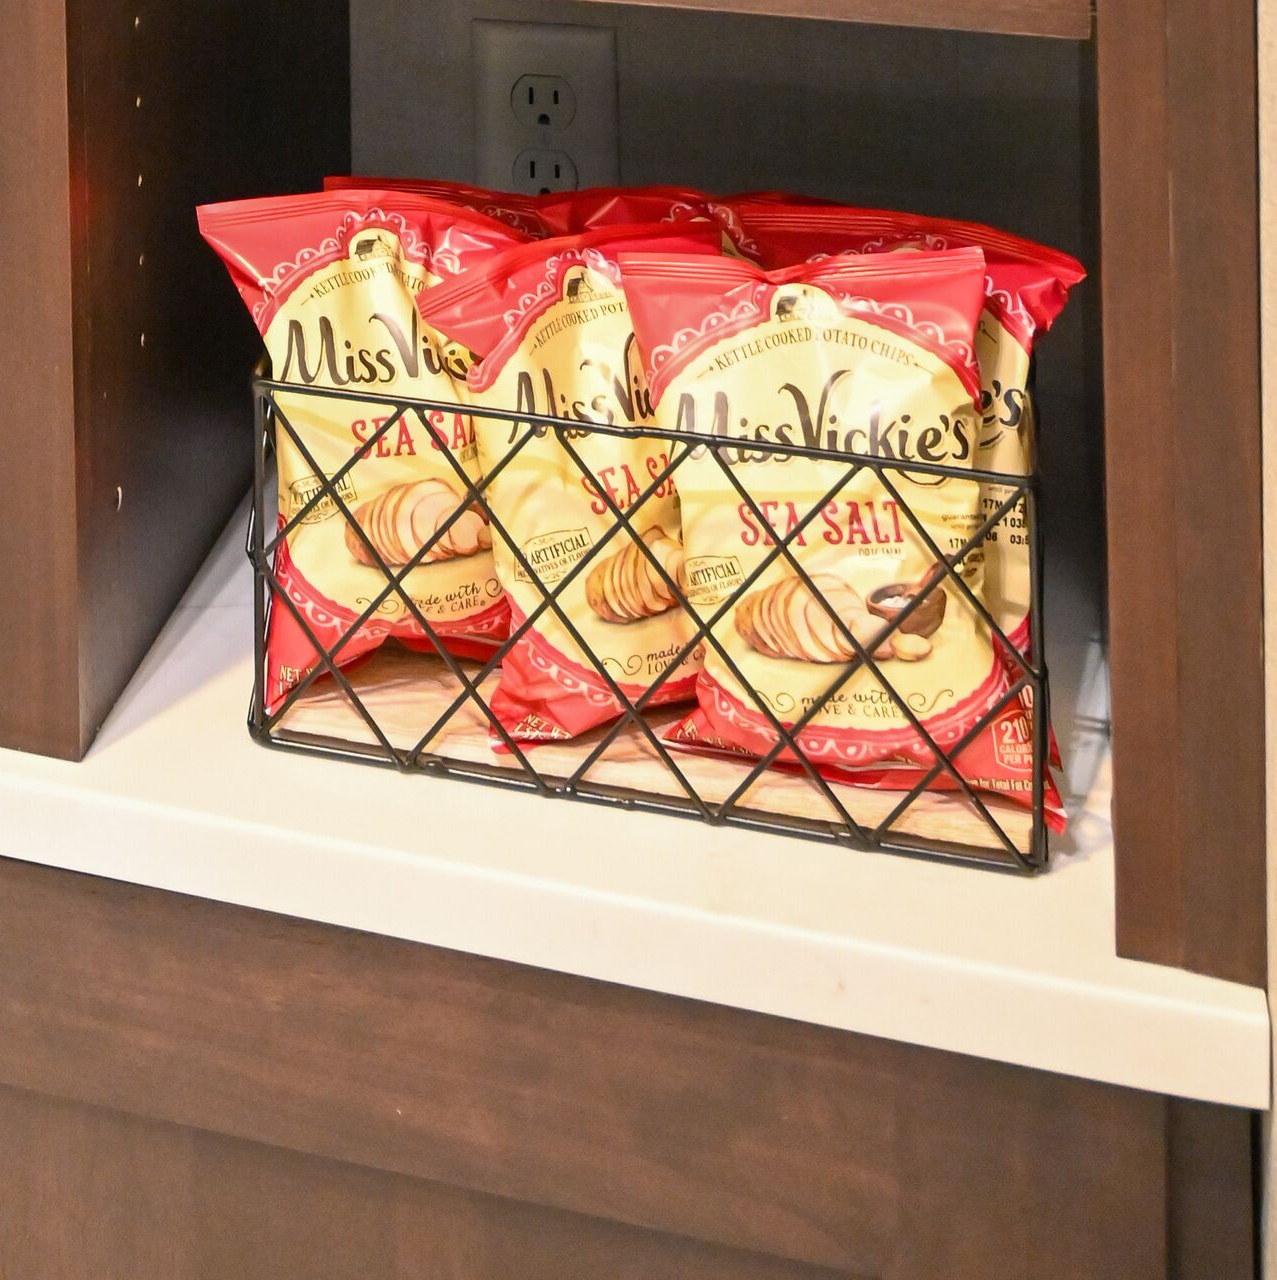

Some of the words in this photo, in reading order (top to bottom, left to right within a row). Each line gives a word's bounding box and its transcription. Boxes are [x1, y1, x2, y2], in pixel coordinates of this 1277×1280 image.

[314, 271, 349, 299] KETTLE
[534, 319, 563, 350] KETTLE
[563, 307, 599, 329] COOKED
[280, 315, 397, 386] Miss
[715, 338, 764, 372] KETTLE
[764, 326, 813, 351] COOKED
[870, 340, 915, 367] CHIPS
[507, 366, 615, 445] Miss
[351, 415, 416, 460] SEA
[669, 390, 794, 468] Miss
[777, 369, 970, 486] Vickie's
[580, 462, 643, 516] SEA
[738, 499, 808, 548] SEA
[822, 499, 905, 547] SALT
[529, 532, 589, 566] ARTIFICIAL
[688, 561, 741, 587] ARTIFICIAL
[445, 582, 481, 604] with
[450, 596, 480, 613] CARE
[646, 642, 682, 663] made
[280, 665, 301, 683] NET
[852, 689, 898, 705] with
[523, 713, 548, 731] NET
[848, 705, 857, 717] &
[864, 705, 899, 719] CARE
[1003, 753, 1022, 764] PER
[991, 779, 1010, 790] Total
